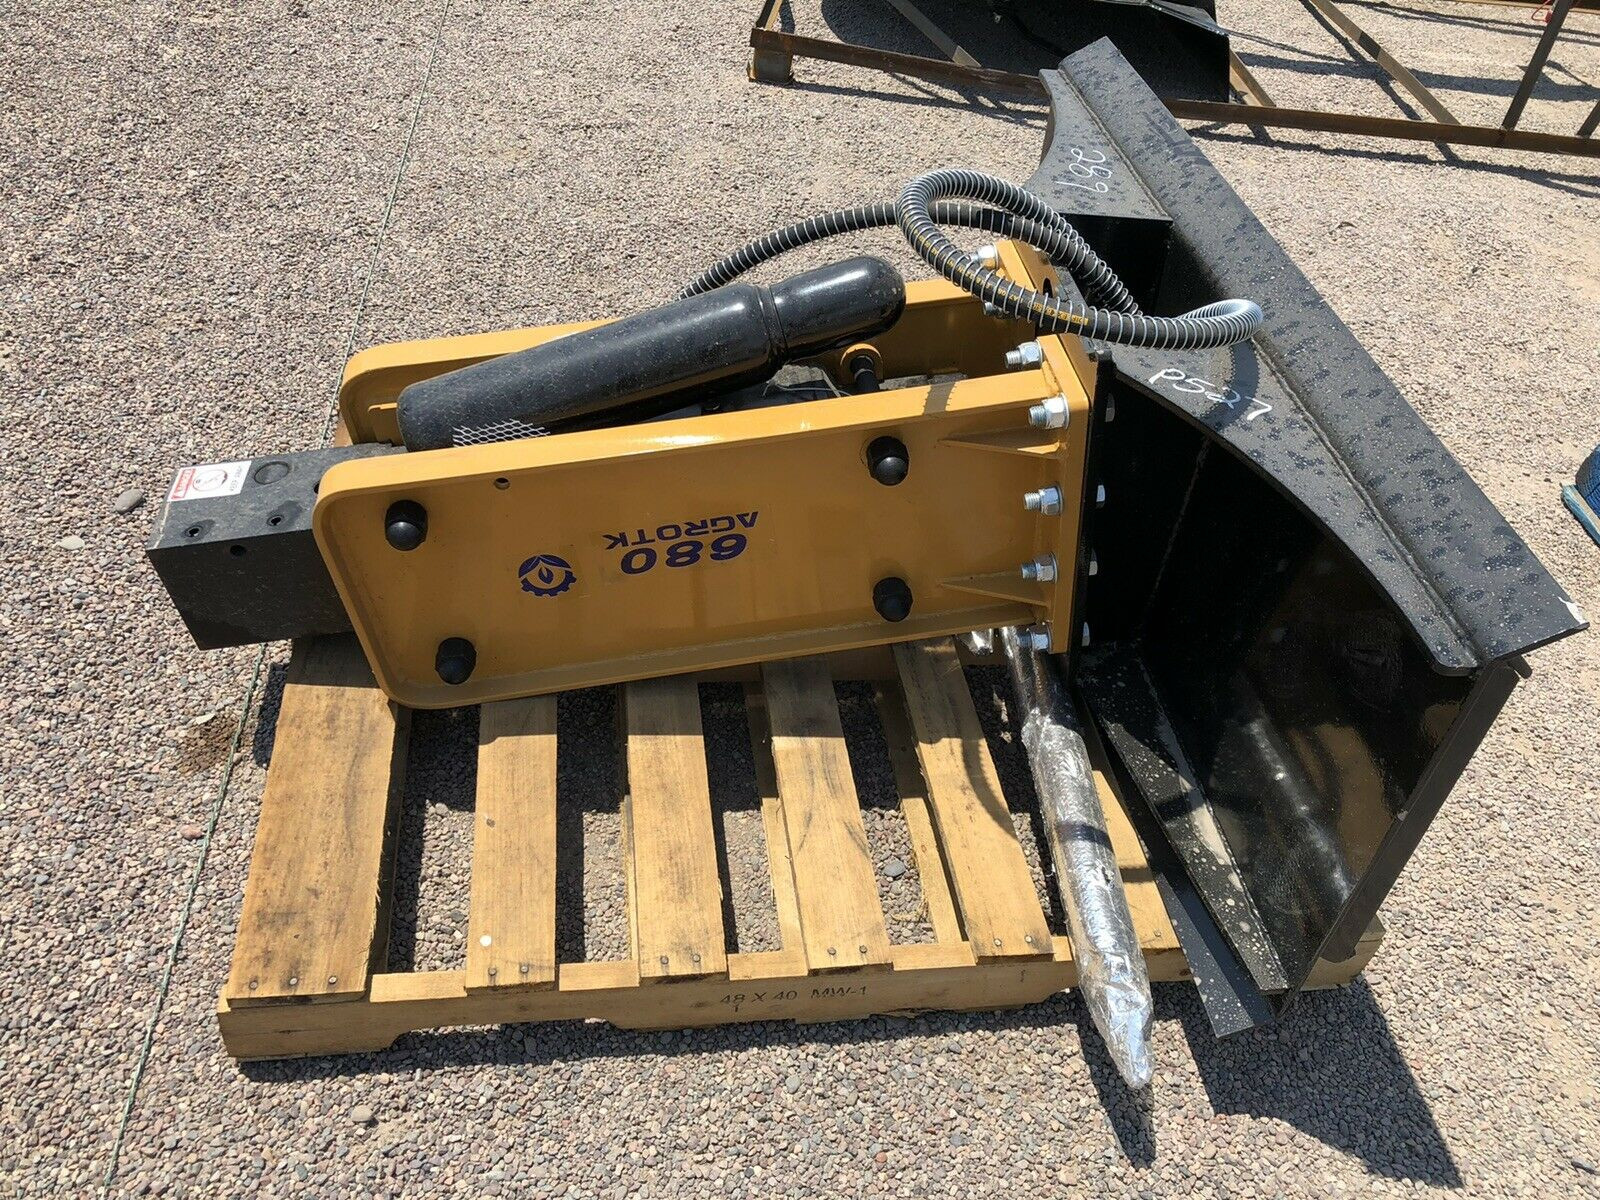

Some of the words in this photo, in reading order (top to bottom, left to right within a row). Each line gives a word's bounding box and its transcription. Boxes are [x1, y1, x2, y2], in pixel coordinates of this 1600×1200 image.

[1055, 147, 1113, 194] 289
[1148, 368, 1273, 421] P527
[602, 511, 759, 551] AGROTK
[621, 534, 747, 575] 680
[720, 993, 746, 1004] 48
[773, 990, 798, 1001] 40
